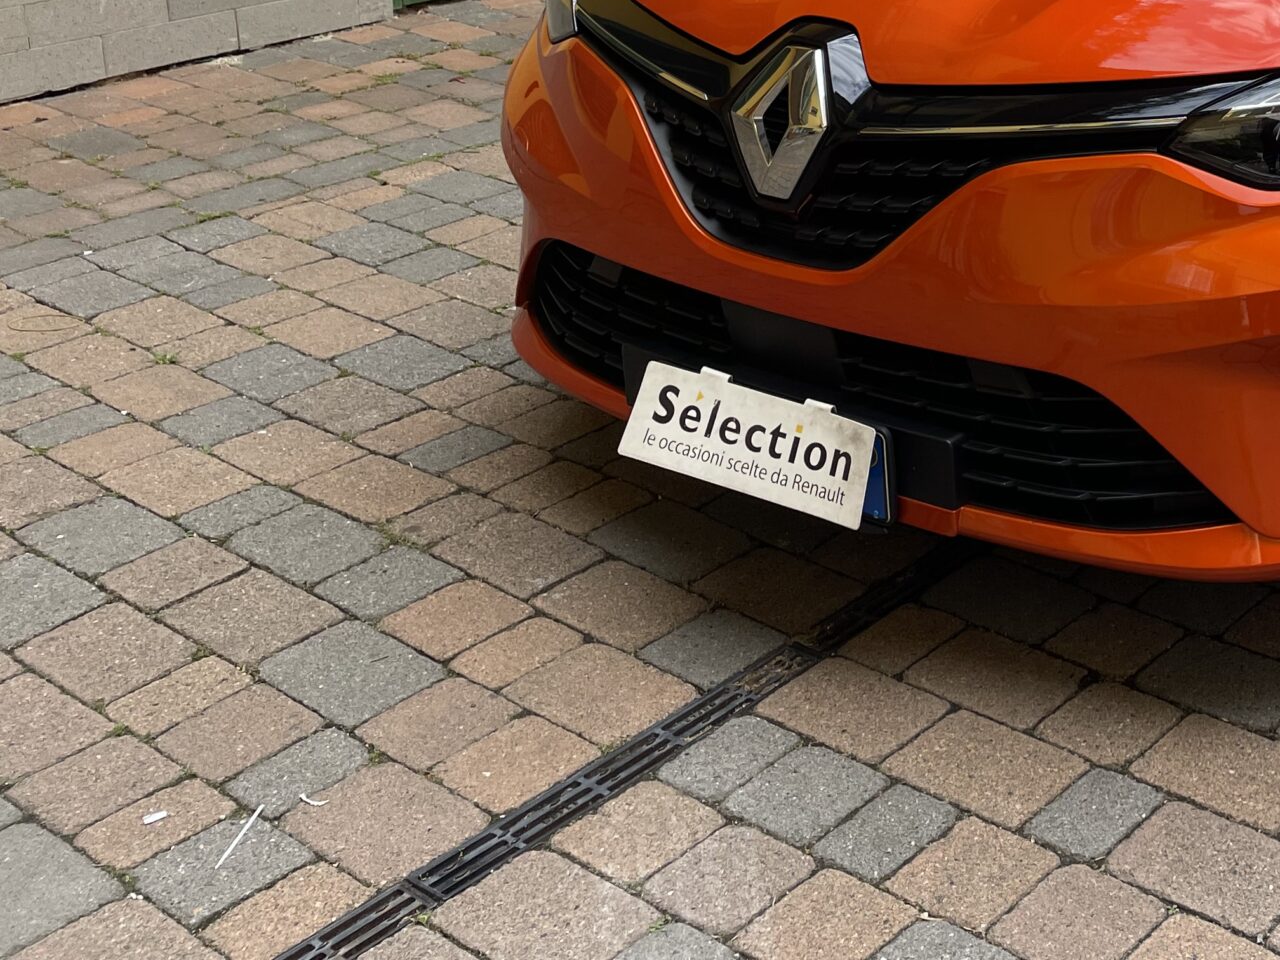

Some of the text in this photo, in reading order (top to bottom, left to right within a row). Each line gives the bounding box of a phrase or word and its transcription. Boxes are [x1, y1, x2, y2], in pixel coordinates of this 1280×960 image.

[643, 428, 846, 506] le occasioni scelte da Renault
